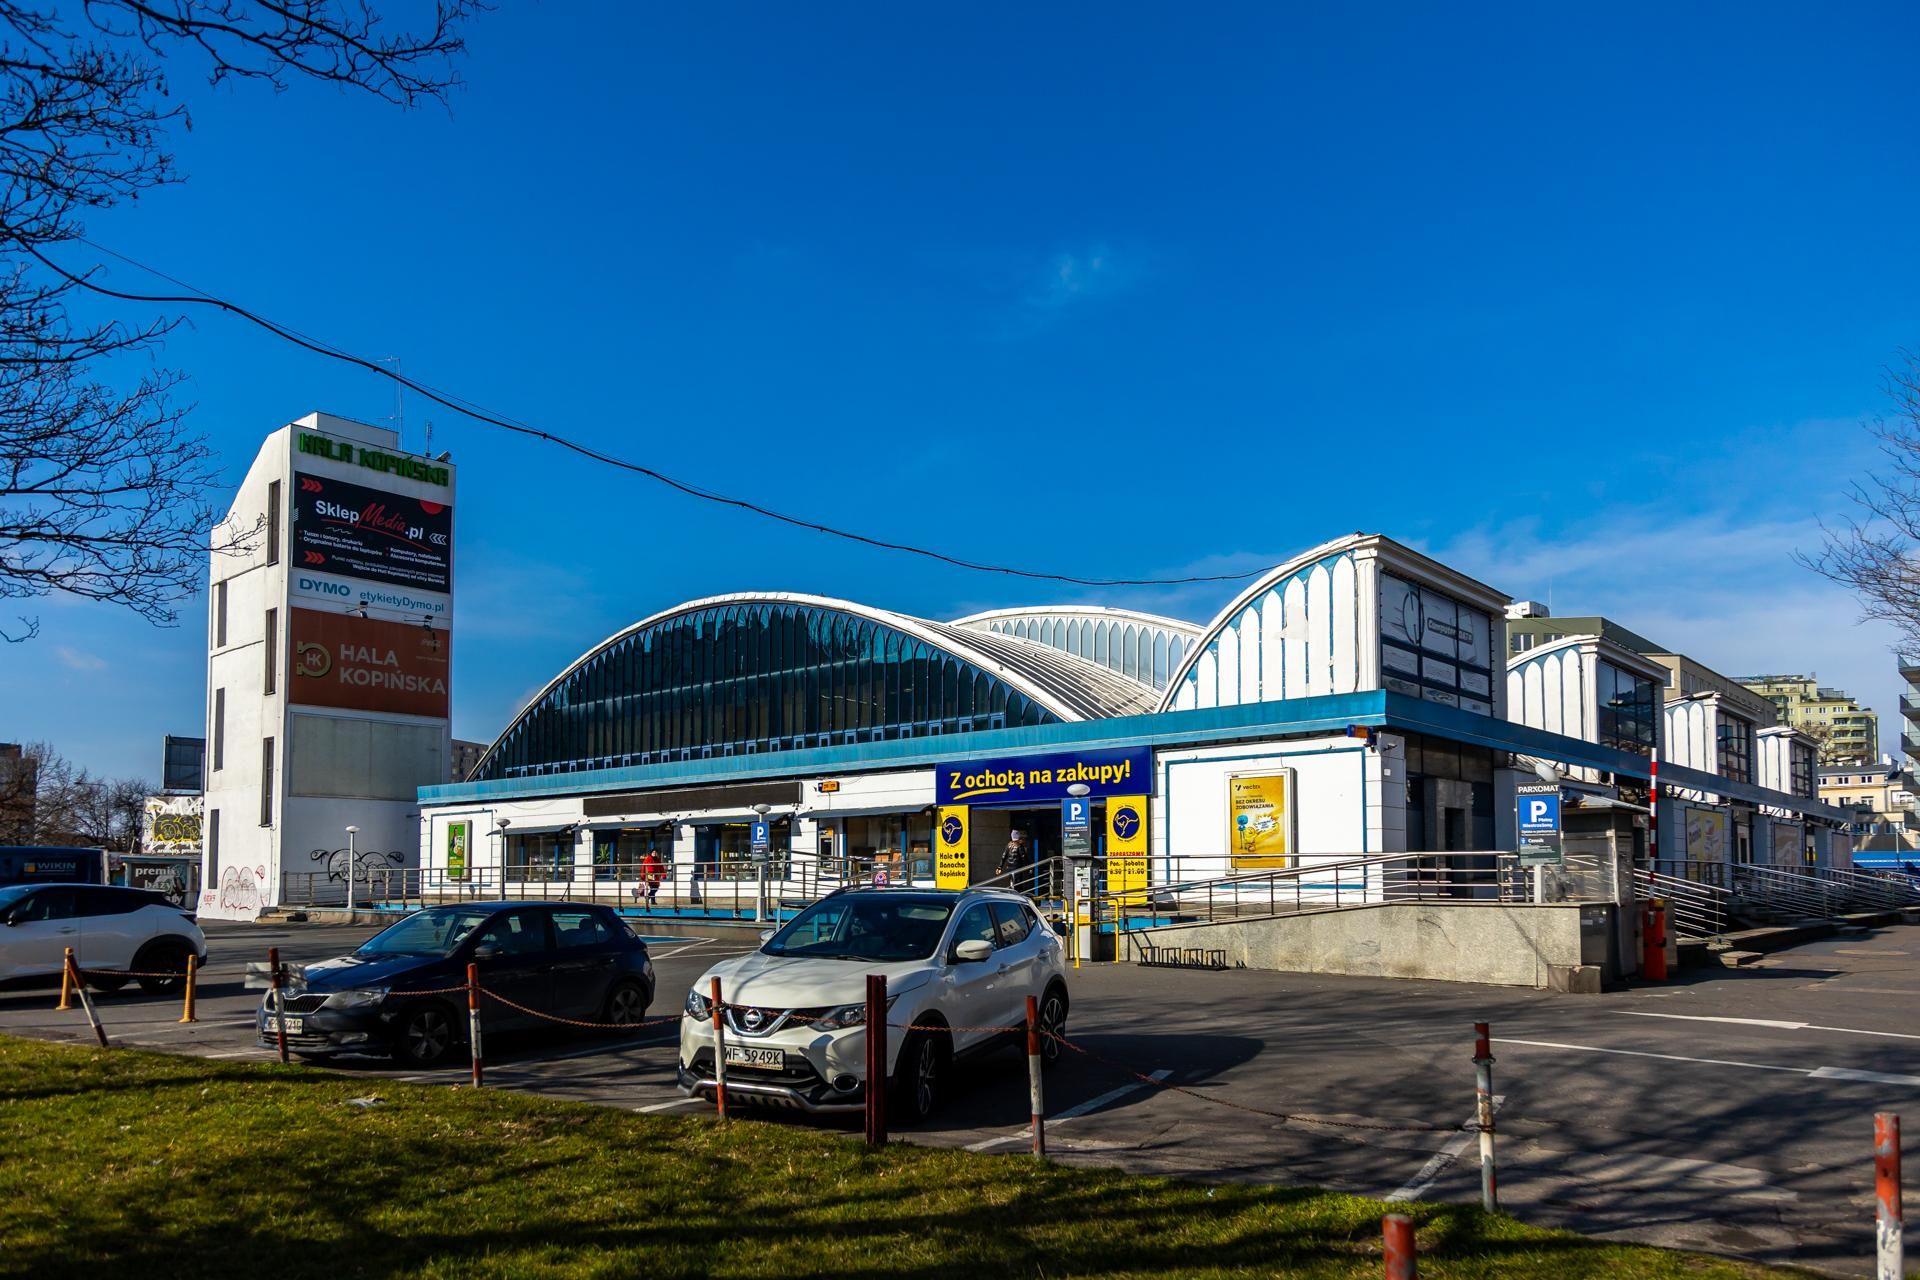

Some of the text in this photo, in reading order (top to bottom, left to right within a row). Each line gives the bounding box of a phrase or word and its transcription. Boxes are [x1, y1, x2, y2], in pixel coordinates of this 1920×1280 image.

[298, 432, 449, 487] HALA KOPIŃSKA
[299, 578, 351, 597] DYMO
[360, 590, 444, 613] etykietyDymo.pl
[306, 652, 322, 667] HK
[340, 643, 399, 667] HALA
[339, 668, 446, 695] KOPIŃSKA
[950, 760, 1131, 790] Z ochotą na zakupy!
[1517, 785, 1559, 794] PARKOMAT
[1071, 803, 1082, 821] P
[1530, 800, 1547, 823] P
[757, 826, 764, 840] P
[939, 869, 966, 878] Kopińska
[724, 1047, 781, 1065] WF 5949K
